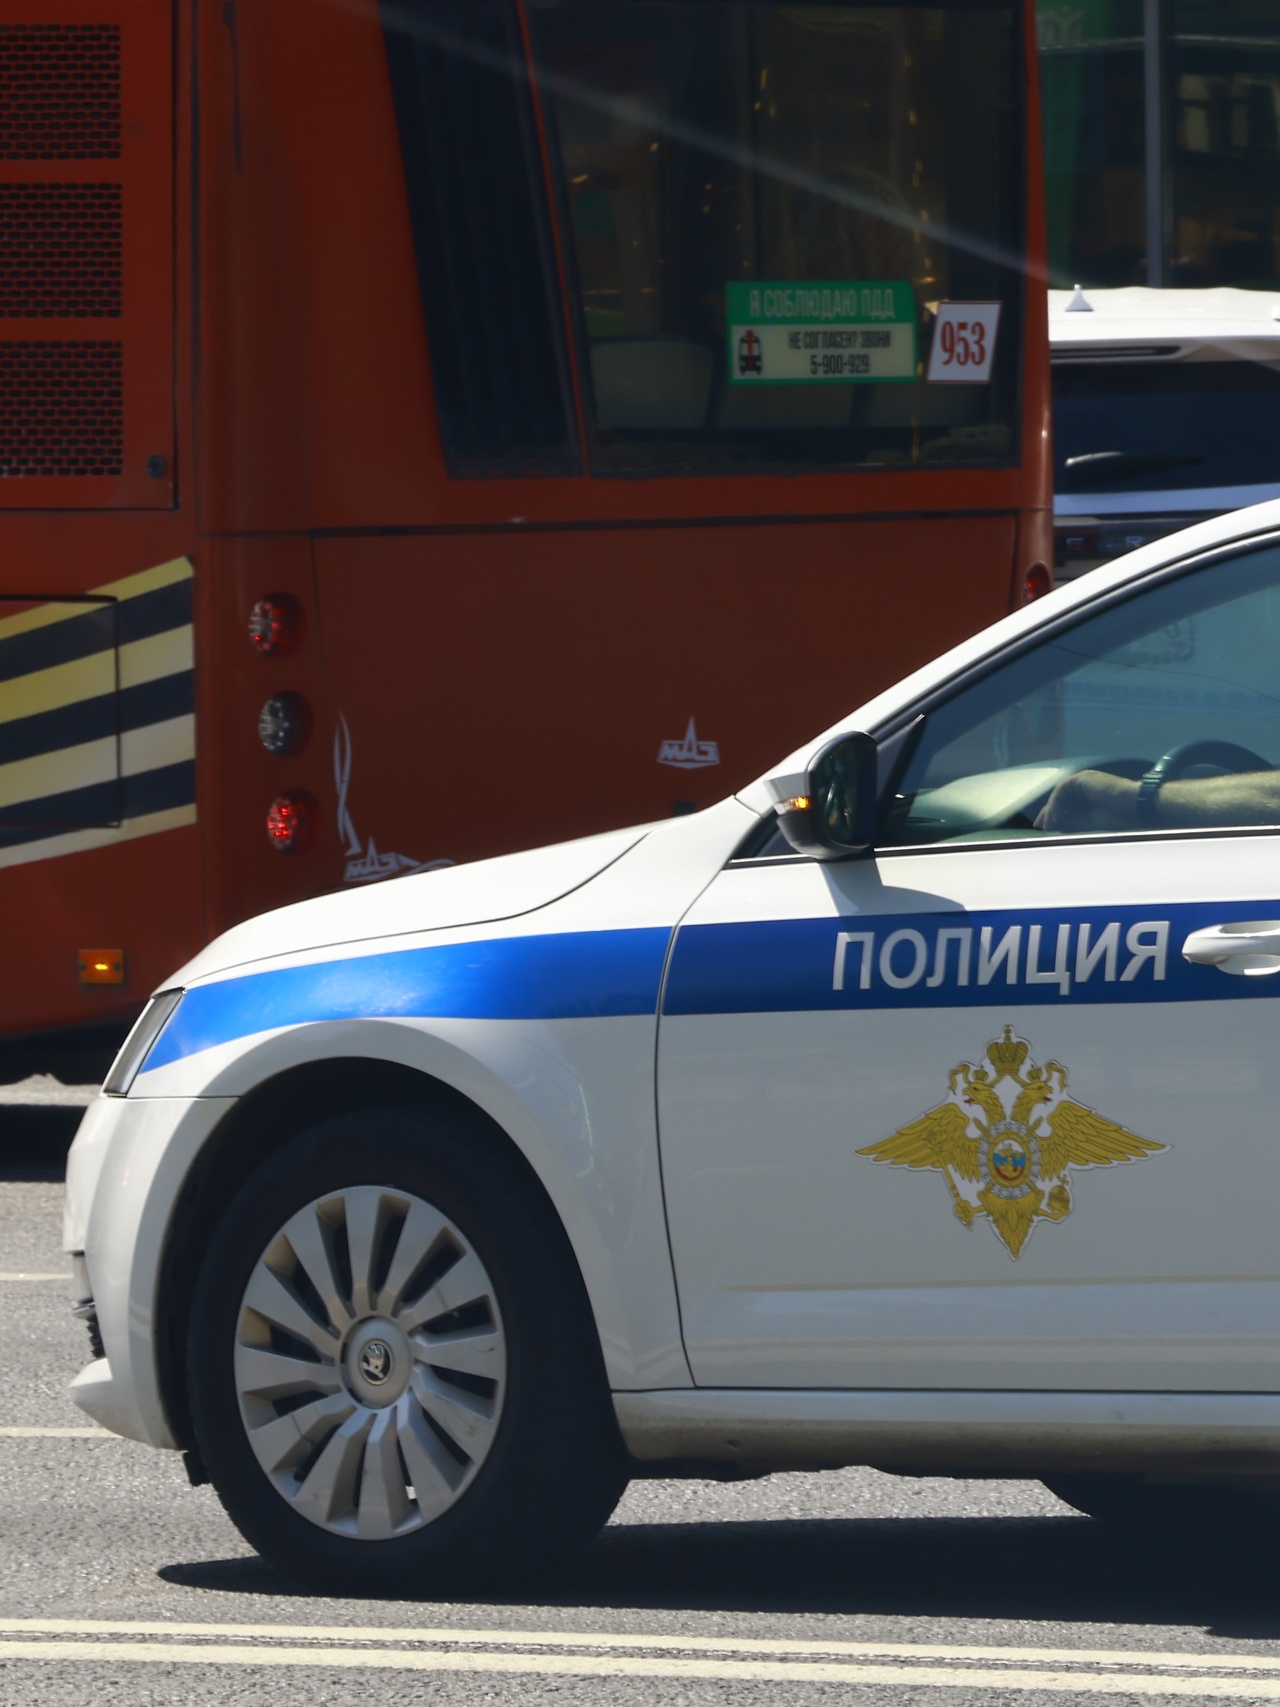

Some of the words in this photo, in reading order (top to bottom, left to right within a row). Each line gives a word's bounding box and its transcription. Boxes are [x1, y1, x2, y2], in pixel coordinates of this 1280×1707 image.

[749, 289, 761, 318] Я
[763, 288, 858, 321] СОБЛЮДАЮ
[861, 288, 897, 320] ПДД
[788, 331, 802, 349] НЕ
[803, 330, 858, 349] СОГЛАСЕН?
[860, 330, 892, 348] ЗВОНИ
[940, 320, 986, 367] 953
[832, 920, 1171, 996] ПОЛИЦИЯ
